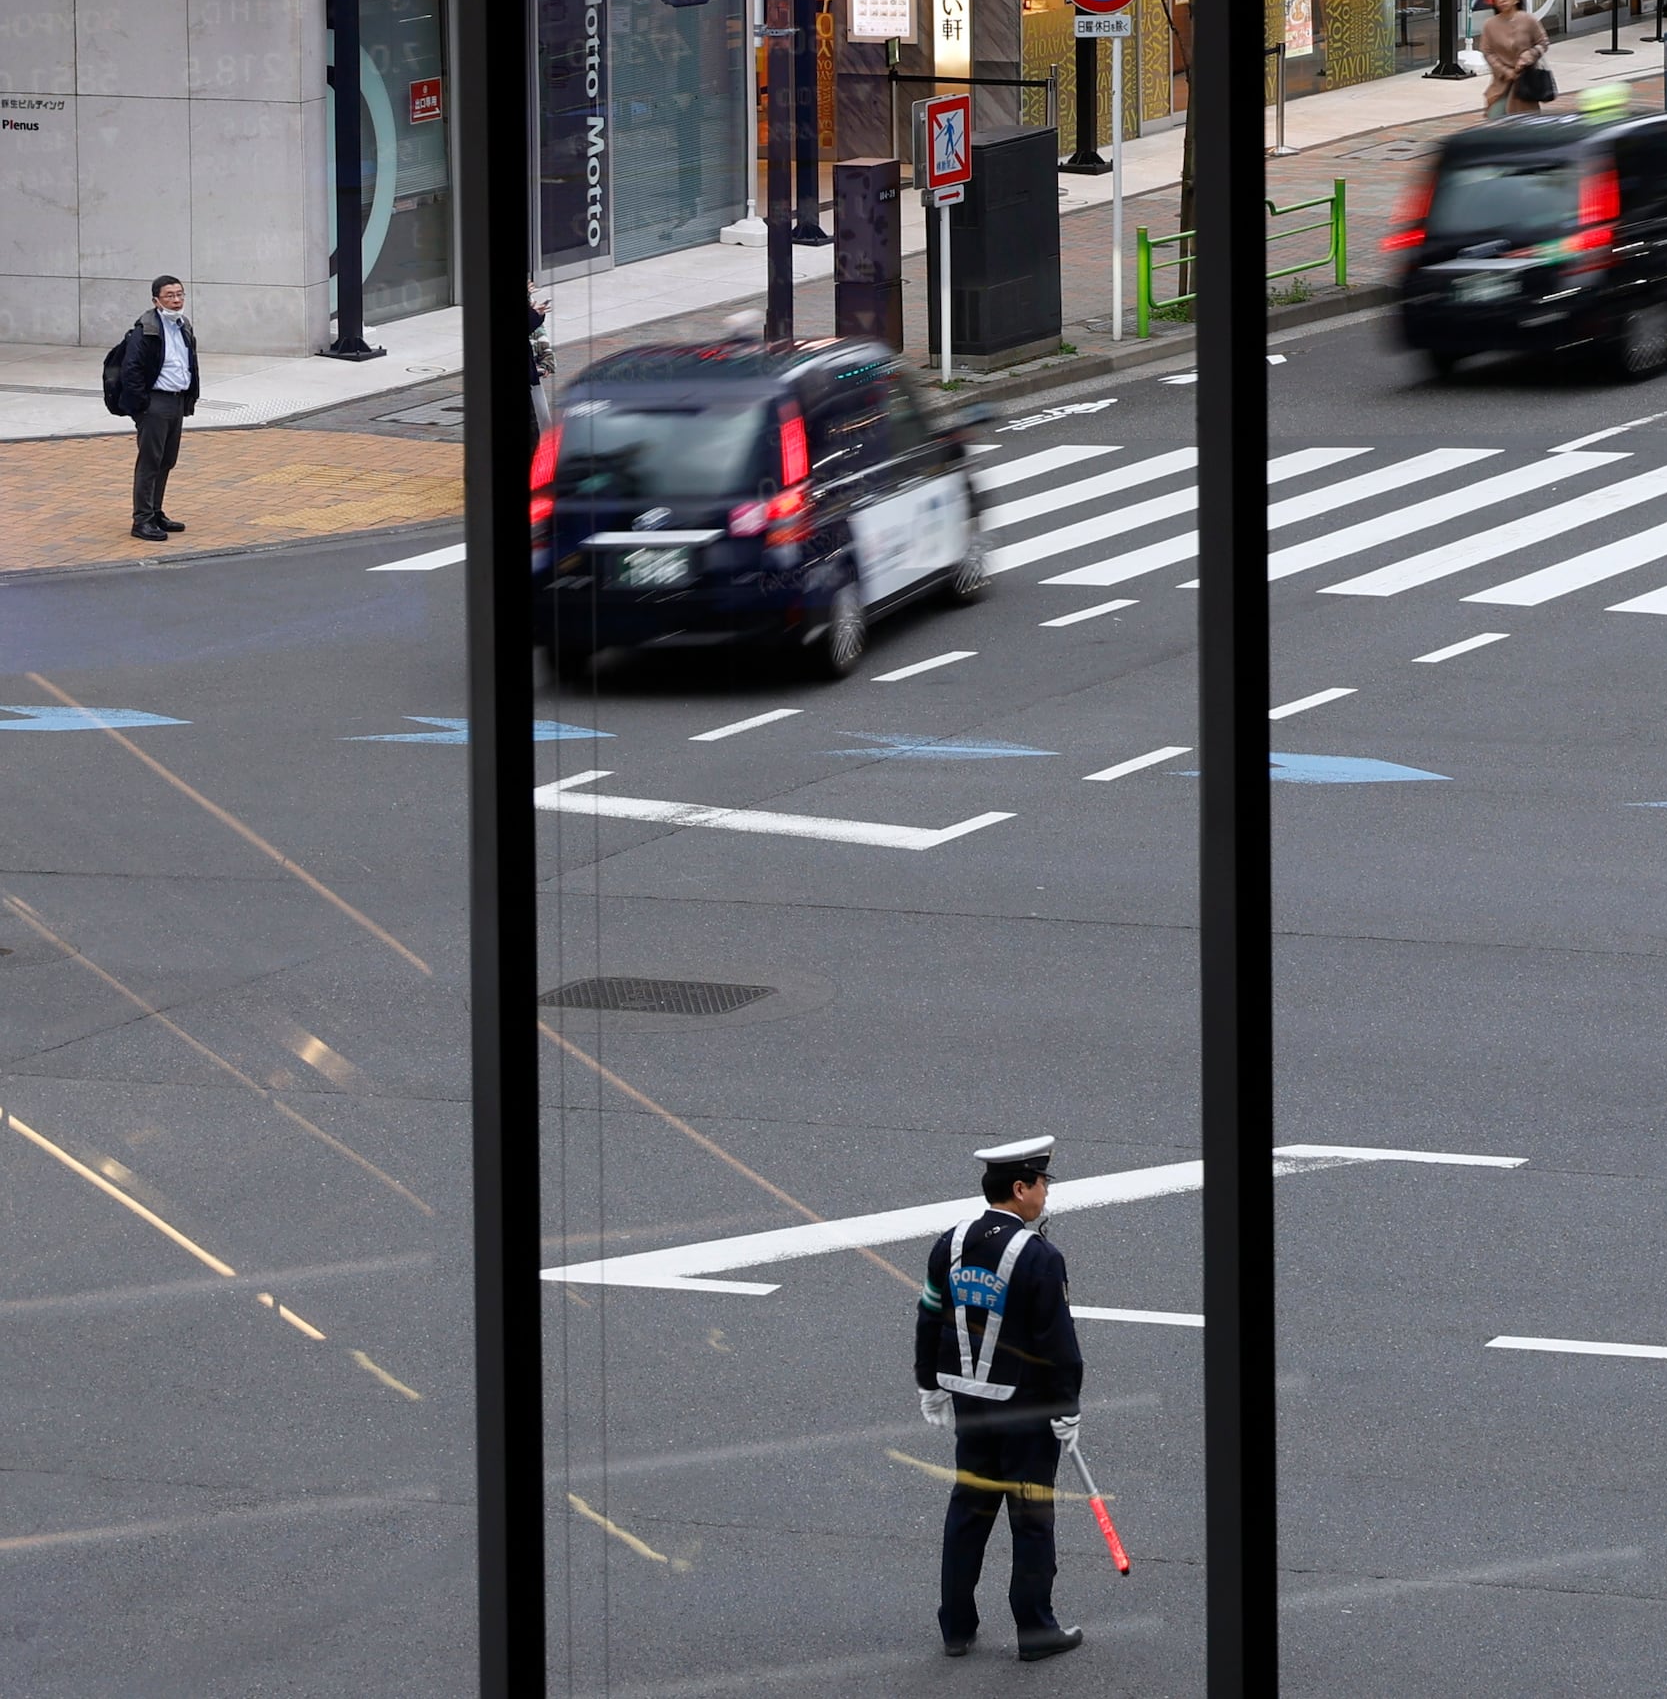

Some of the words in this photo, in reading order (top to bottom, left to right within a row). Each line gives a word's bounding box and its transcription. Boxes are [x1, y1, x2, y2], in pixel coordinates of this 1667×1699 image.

[2, 119, 40, 131] Plenus
[586, 116, 606, 248] Motto
[951, 1269, 1005, 1294] POLICE
